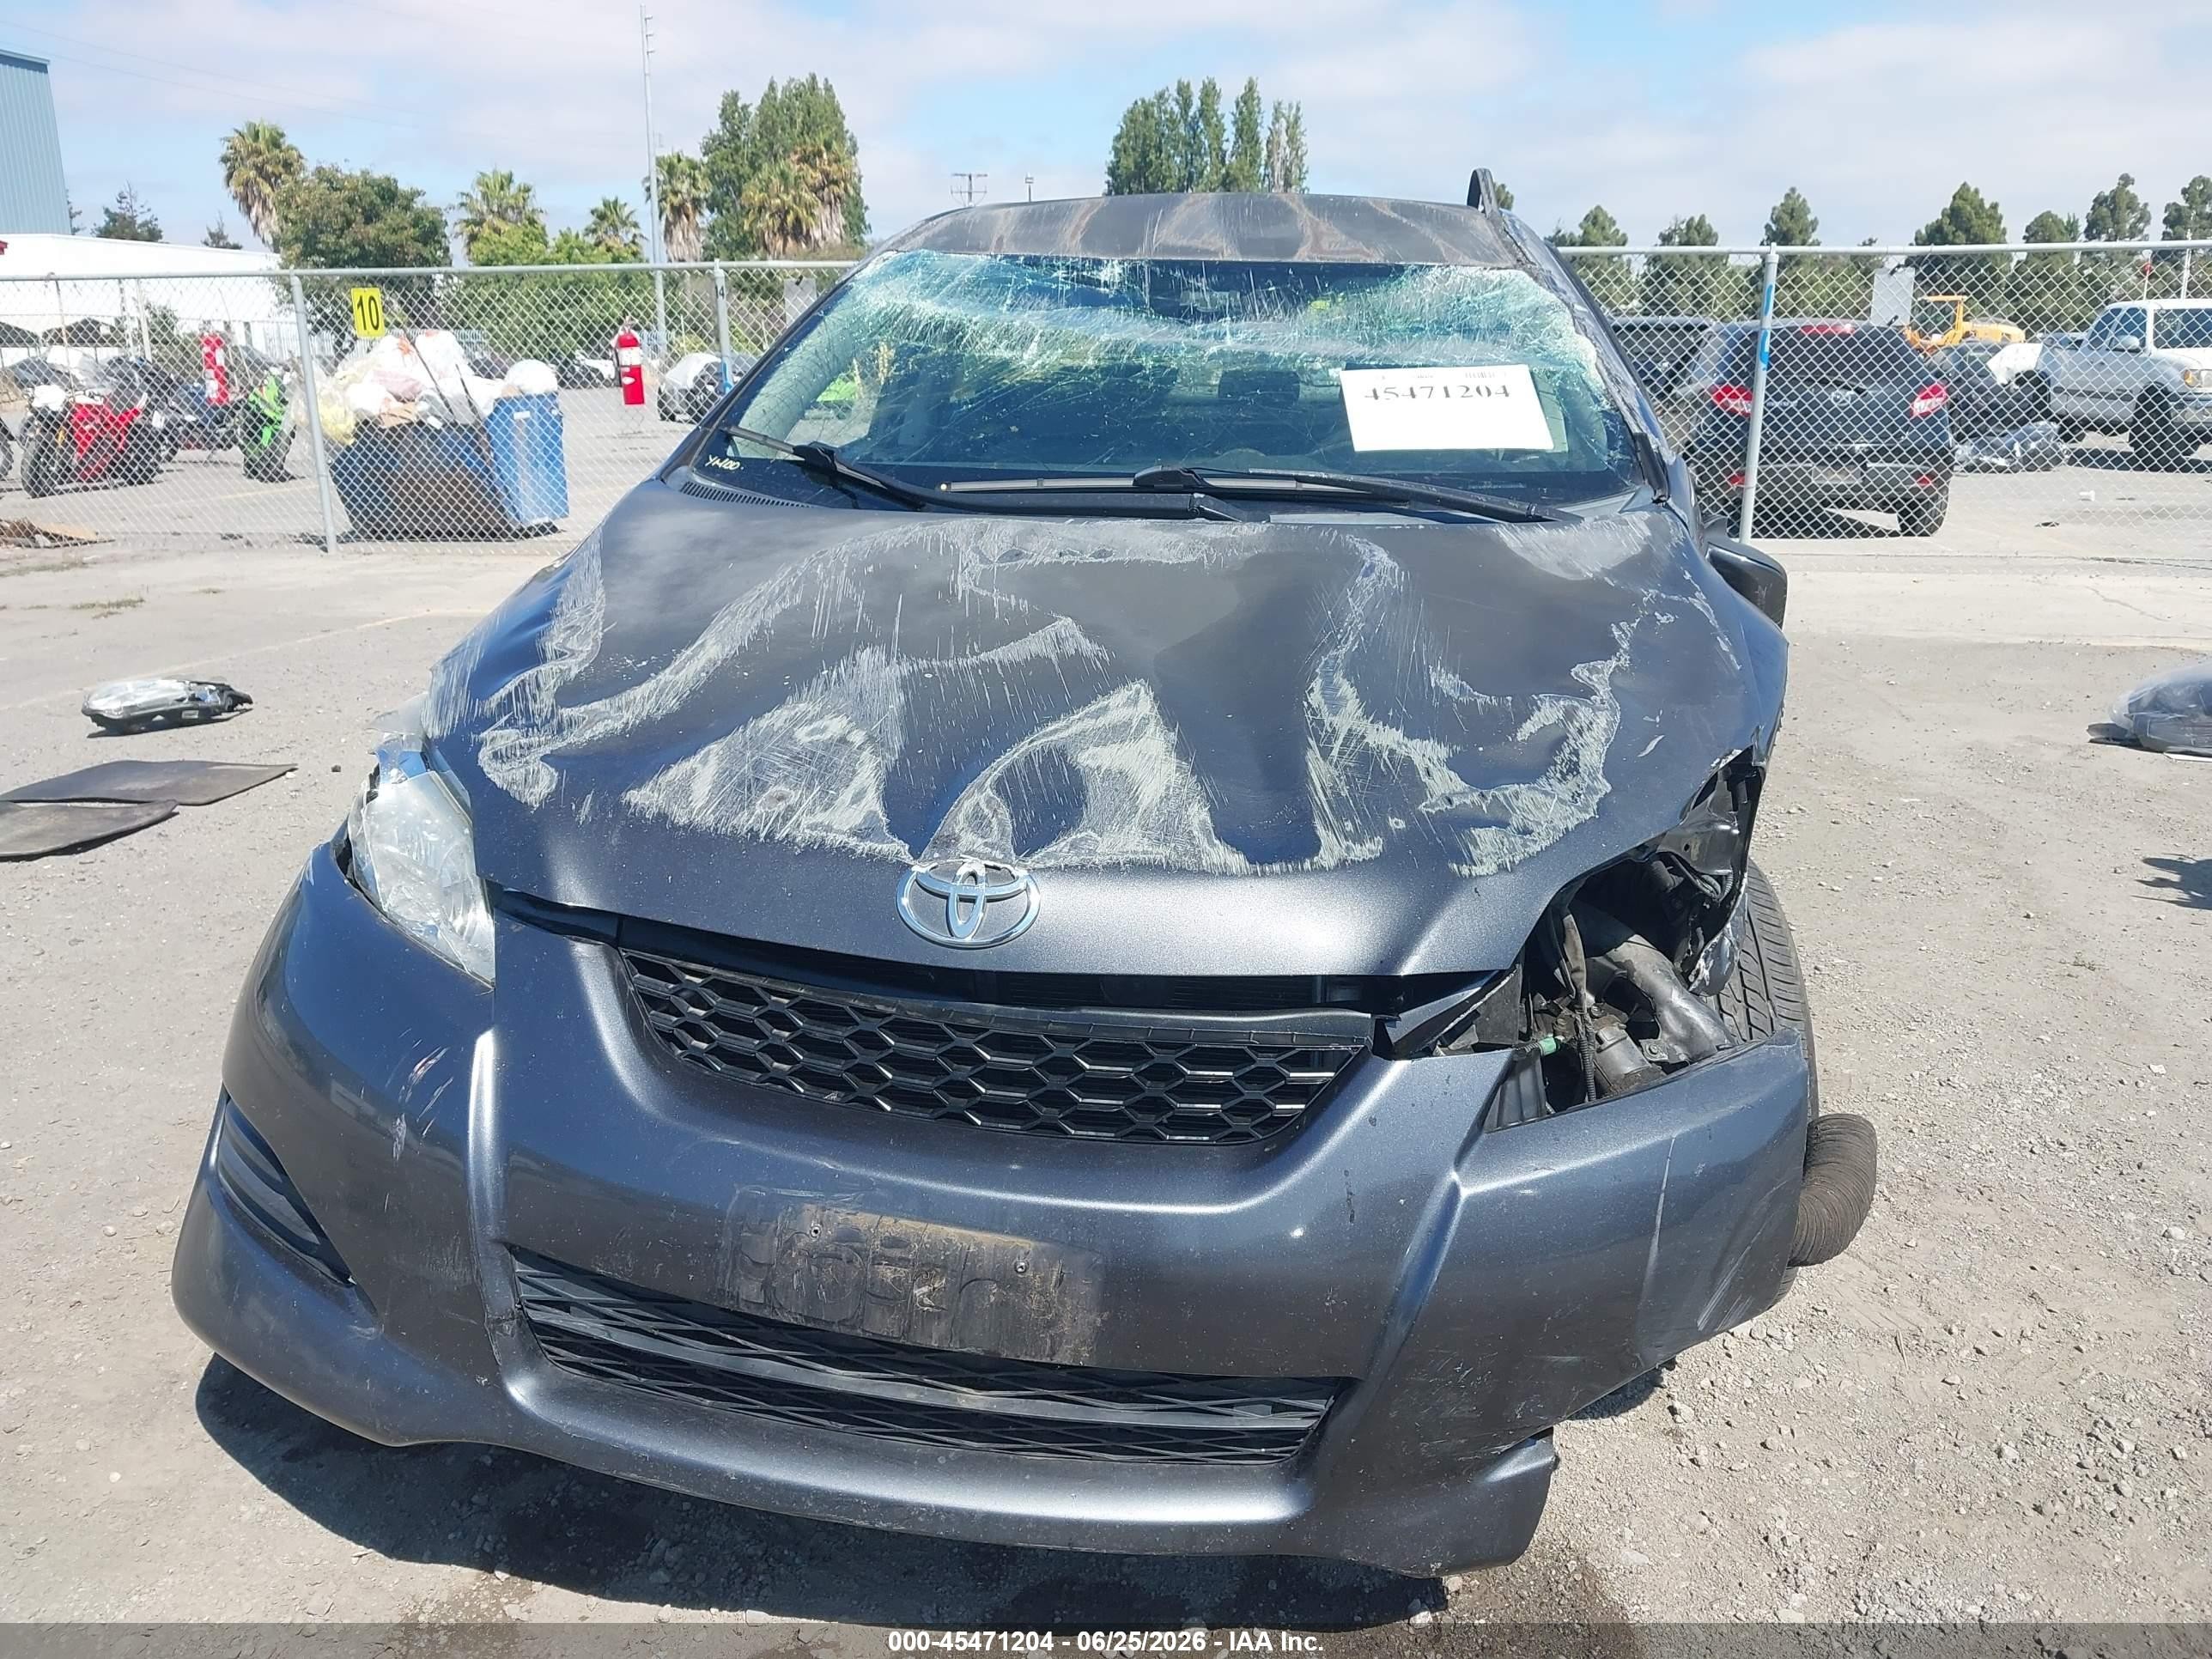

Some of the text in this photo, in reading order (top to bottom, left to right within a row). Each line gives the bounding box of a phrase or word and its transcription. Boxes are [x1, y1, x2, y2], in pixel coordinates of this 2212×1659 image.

[714, 285, 725, 300] 14
[356, 295, 380, 331] 10
[1364, 385, 1510, 400] 45471204
